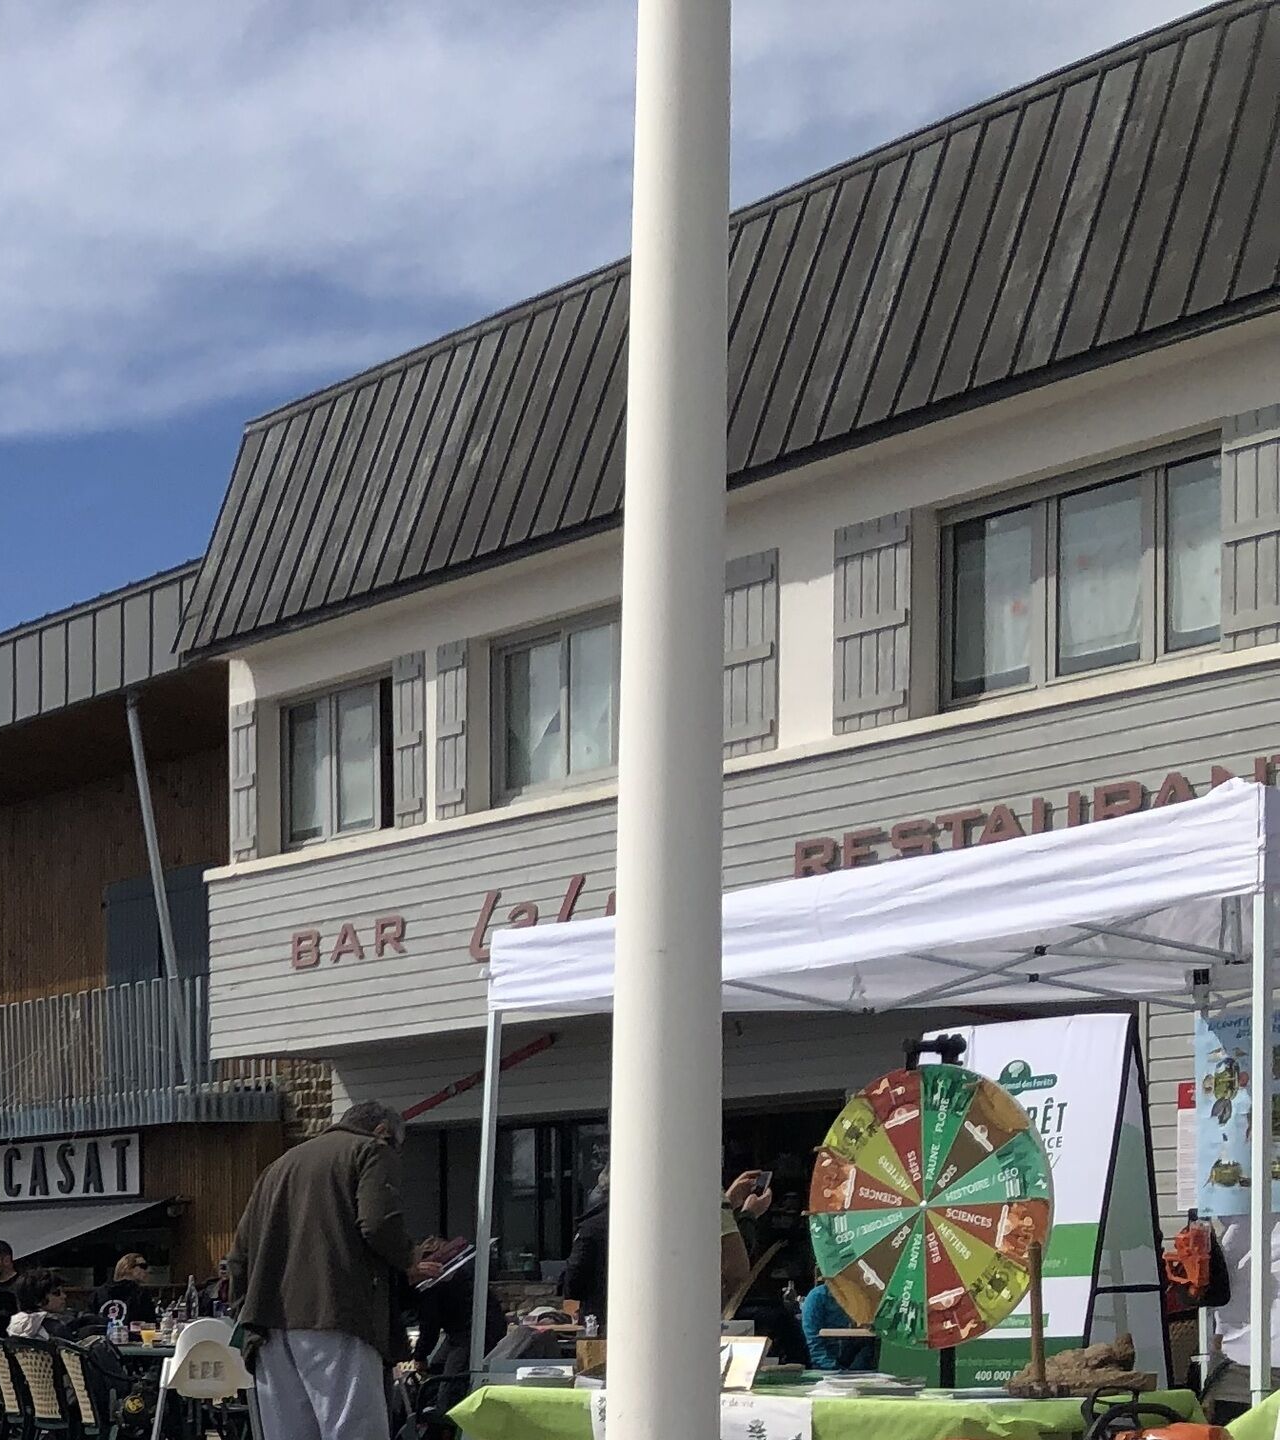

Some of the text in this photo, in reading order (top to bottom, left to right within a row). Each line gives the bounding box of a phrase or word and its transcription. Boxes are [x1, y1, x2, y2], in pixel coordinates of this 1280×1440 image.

[794, 754, 1280, 878] RESTAURAN
[291, 914, 408, 970] BAR
[1026, 1097, 1068, 1135] RÊT
[925, 1098, 951, 1180] FAUNE FLORE
[3, 1138, 131, 1198] CASAT
[937, 1164, 958, 1188] BOIS
[945, 1178, 990, 1201] HISTOIRE
[997, 1167, 1019, 1182] GÉO
[858, 1186, 902, 1207] SCIENCES
[862, 1211, 904, 1235] HISTOIRE
[945, 1208, 993, 1228] SCIENCES
[891, 1225, 912, 1250] BOIS
[937, 1222, 972, 1261] MÉTIERS
[899, 1233, 923, 1315] FAUNE FLORE
[974, 1370, 992, 1382] 400
[993, 1370, 1011, 1381] 000
